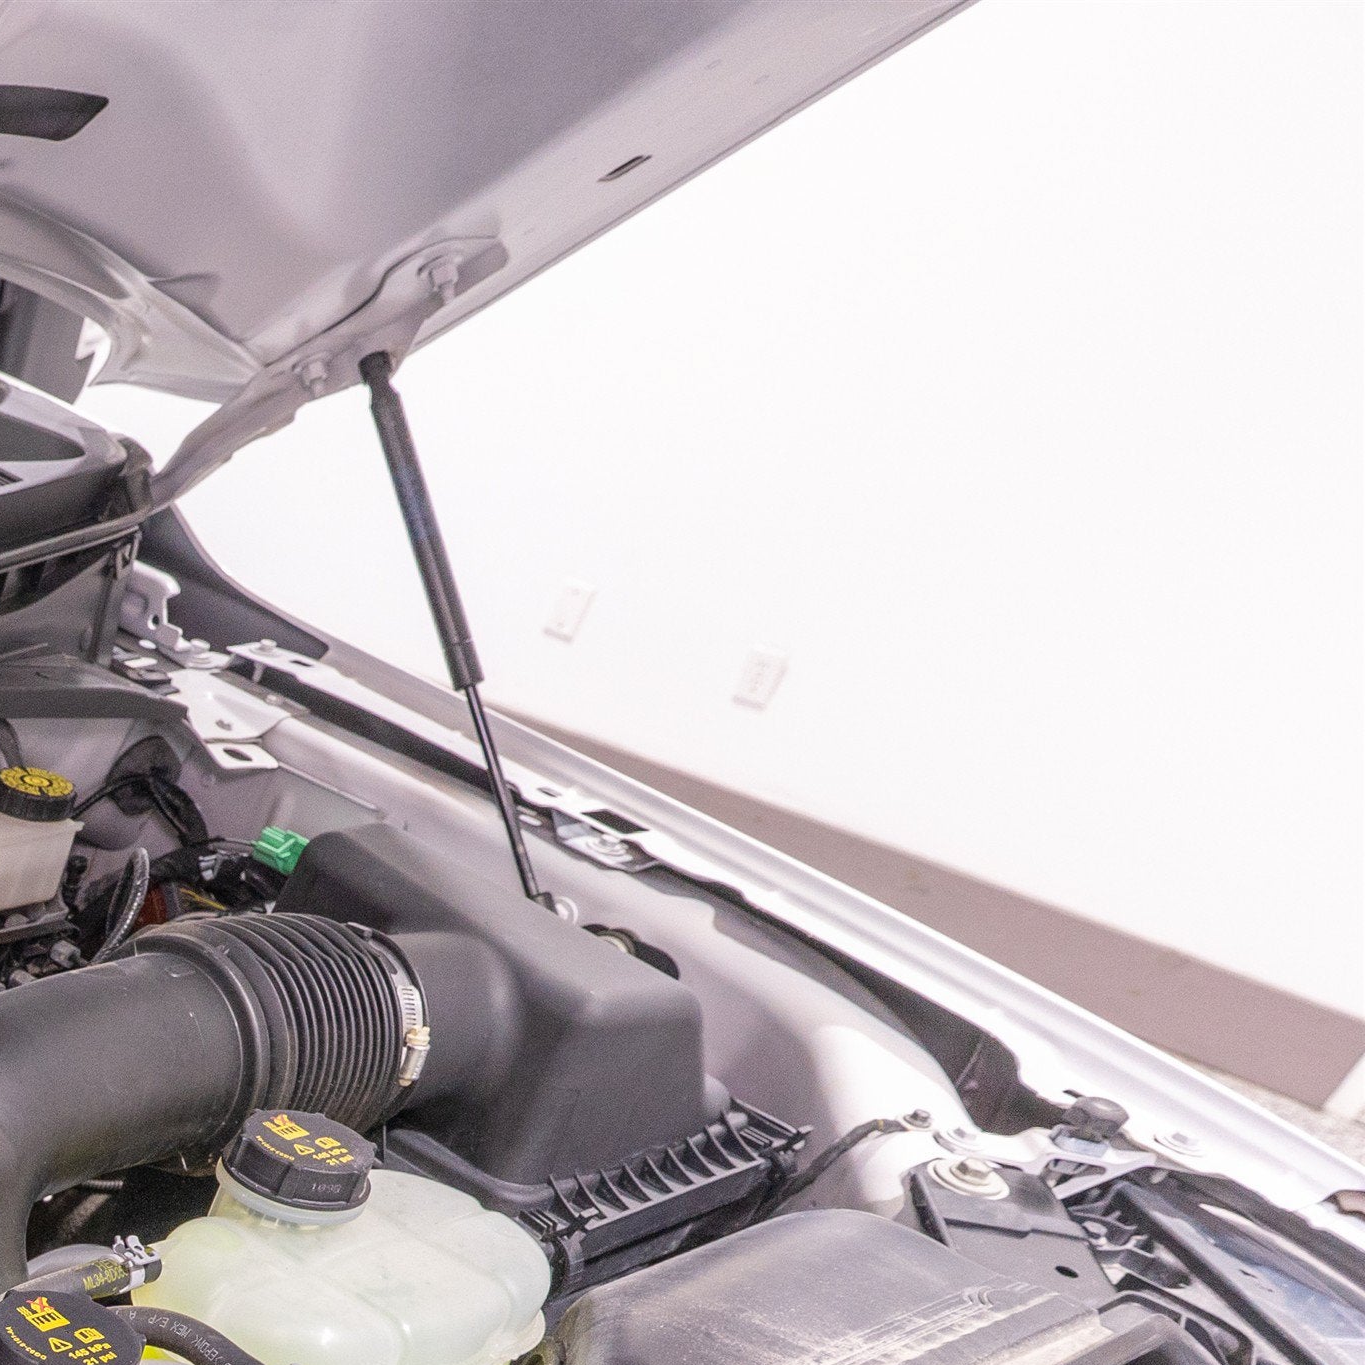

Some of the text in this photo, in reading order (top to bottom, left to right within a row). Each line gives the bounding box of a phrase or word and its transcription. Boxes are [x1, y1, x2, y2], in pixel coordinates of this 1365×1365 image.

[68, 1342, 112, 1360] 145 kPa
[98, 1351, 118, 1363] psi
